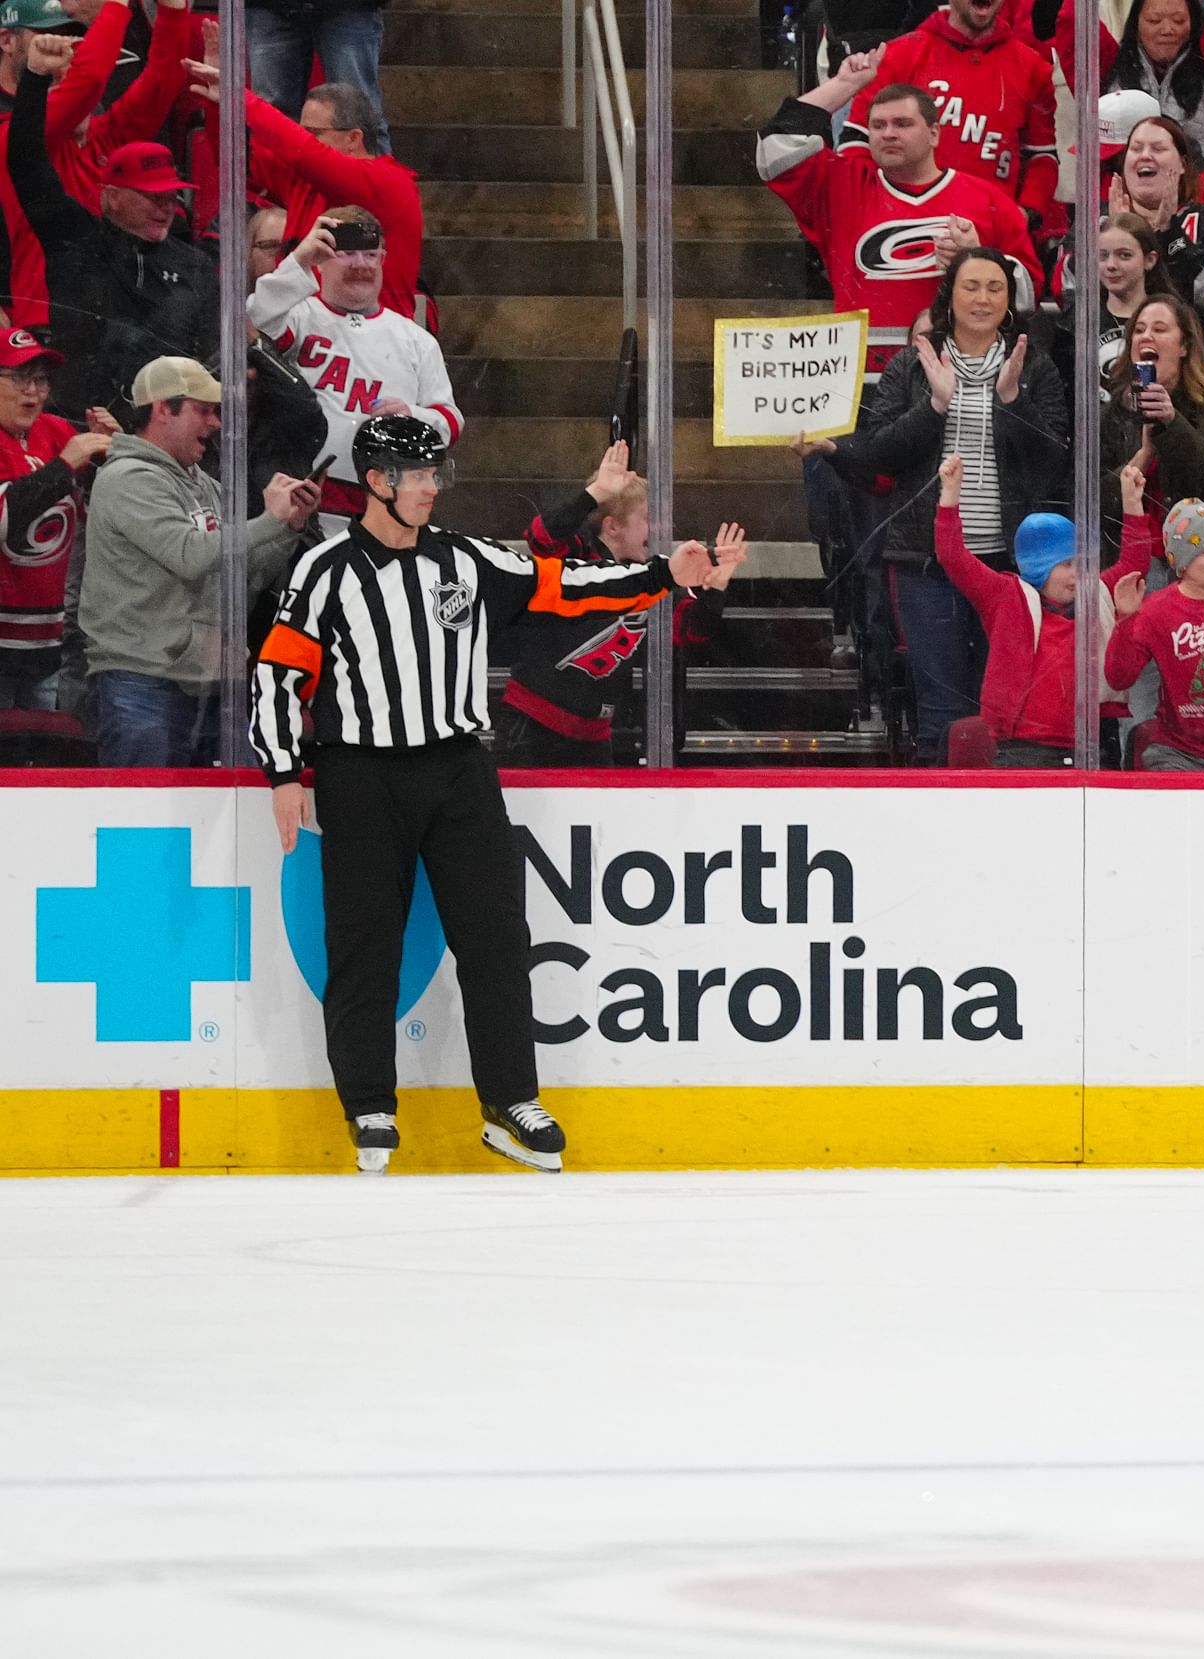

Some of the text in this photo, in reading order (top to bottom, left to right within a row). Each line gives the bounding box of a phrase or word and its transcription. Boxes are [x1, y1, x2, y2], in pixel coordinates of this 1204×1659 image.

[732, 331, 774, 350] IT'S
[789, 330, 818, 349] MY
[754, 392, 830, 414] PUCK?
[442, 594, 467, 619] NHL
[511, 824, 854, 926] North
[527, 935, 1024, 1045] Carolina
